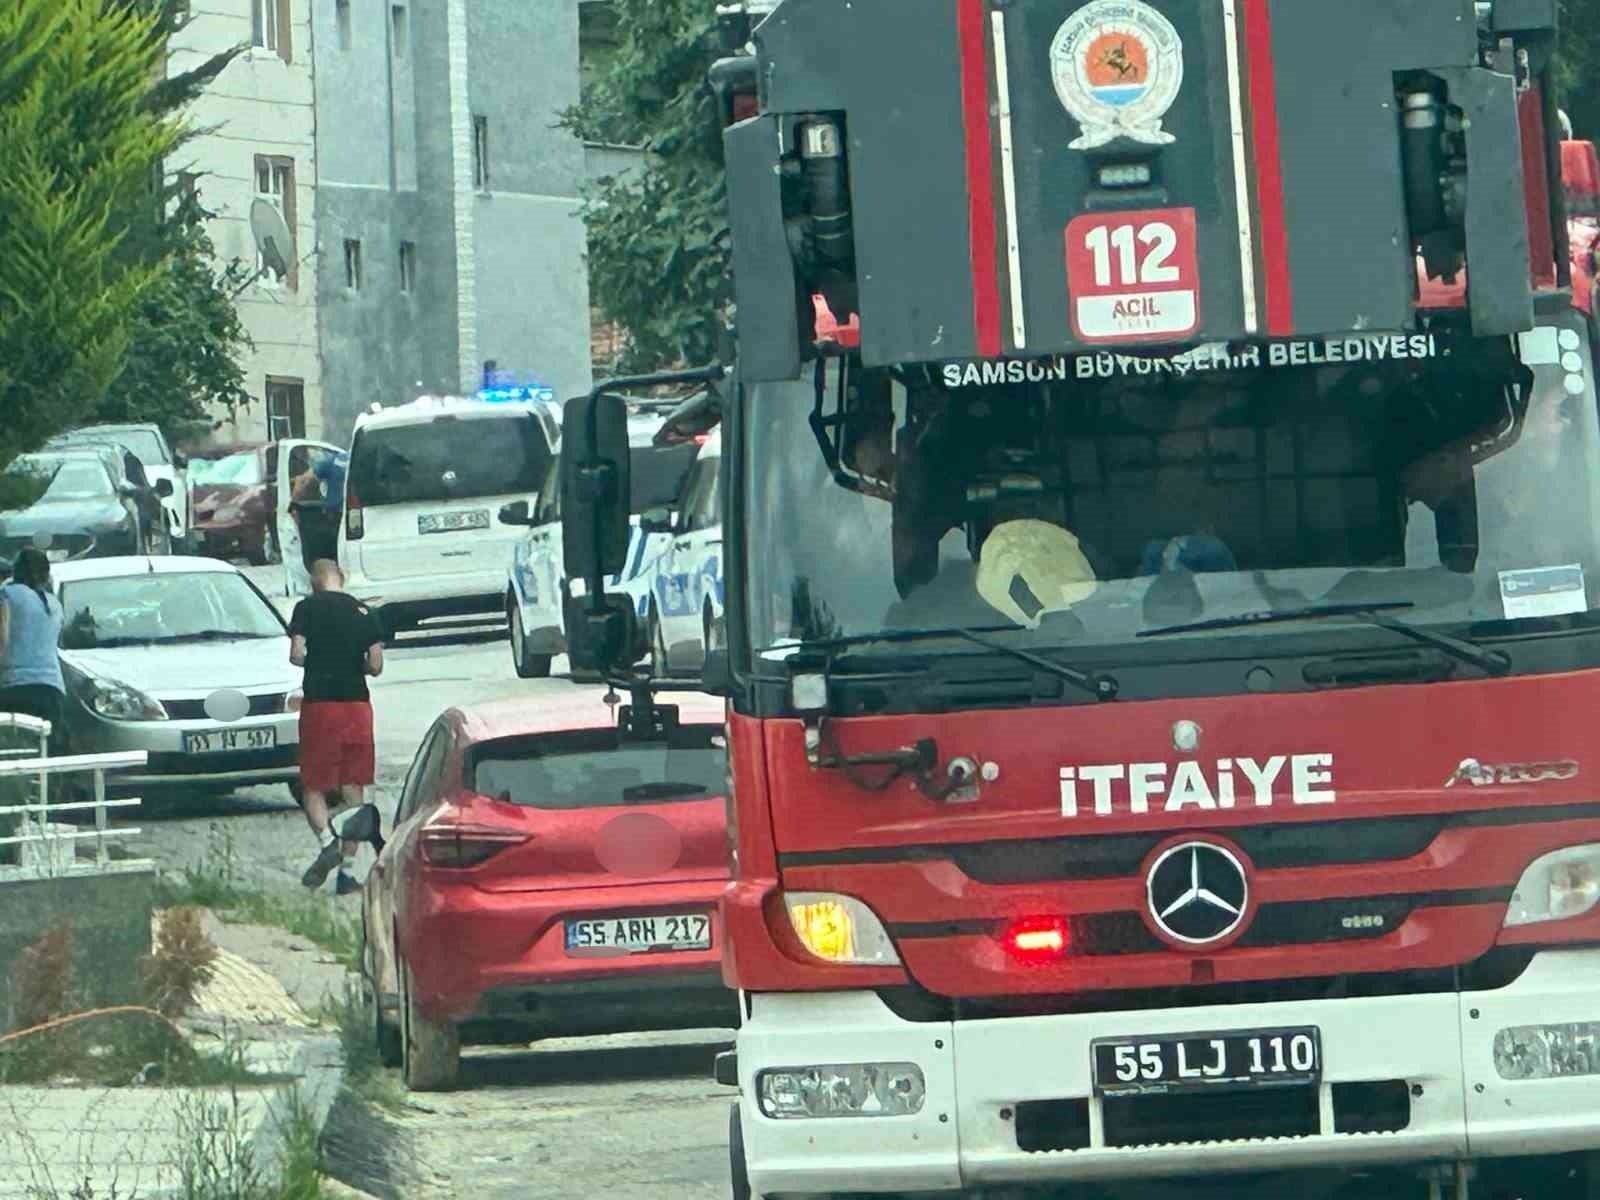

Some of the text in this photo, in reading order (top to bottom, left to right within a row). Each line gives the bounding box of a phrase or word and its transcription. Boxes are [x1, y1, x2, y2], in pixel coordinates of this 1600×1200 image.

[1085, 222, 1180, 286] 112
[578, 916, 707, 945] 55 ARH 217
[1115, 1035, 1314, 1081] 55 LJ 110
